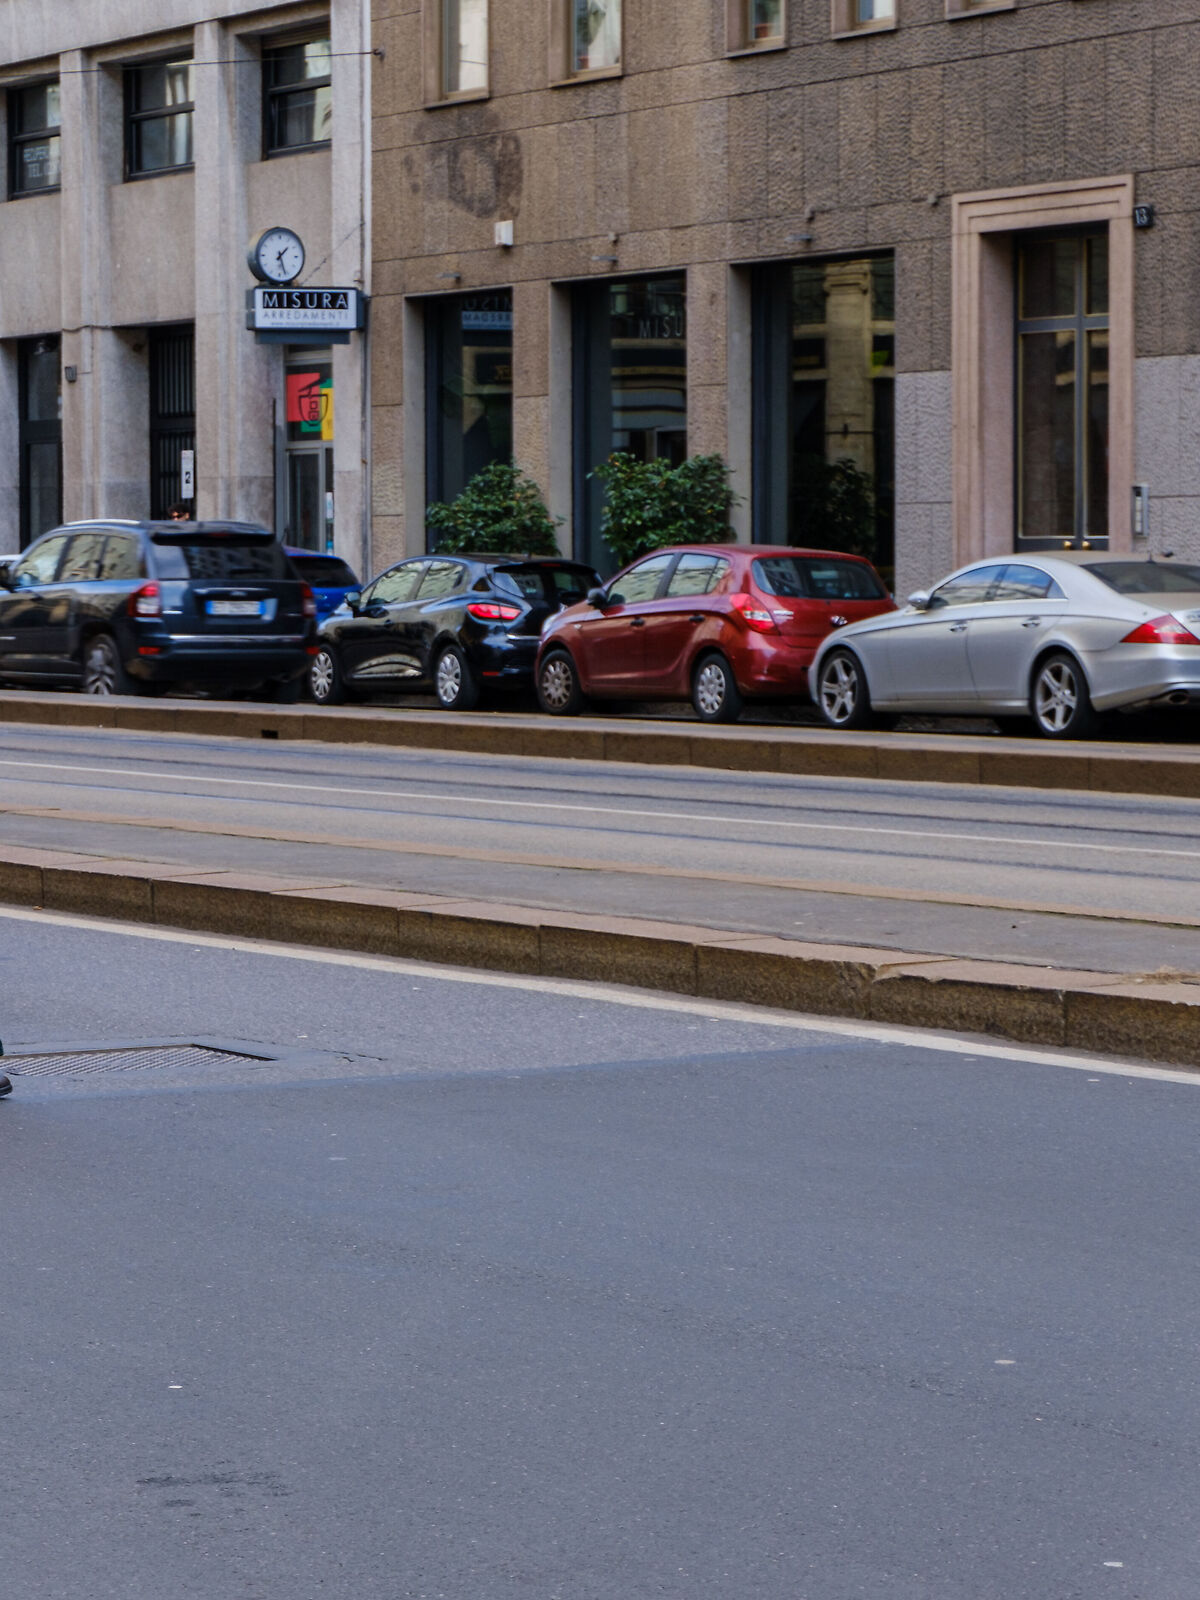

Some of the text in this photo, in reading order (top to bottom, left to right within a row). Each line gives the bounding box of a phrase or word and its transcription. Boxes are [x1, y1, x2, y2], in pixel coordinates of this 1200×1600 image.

[1135, 208, 1147, 225] 13
[263, 291, 348, 308] MISURA
[263, 309, 349, 321] ARREDAMENTI
